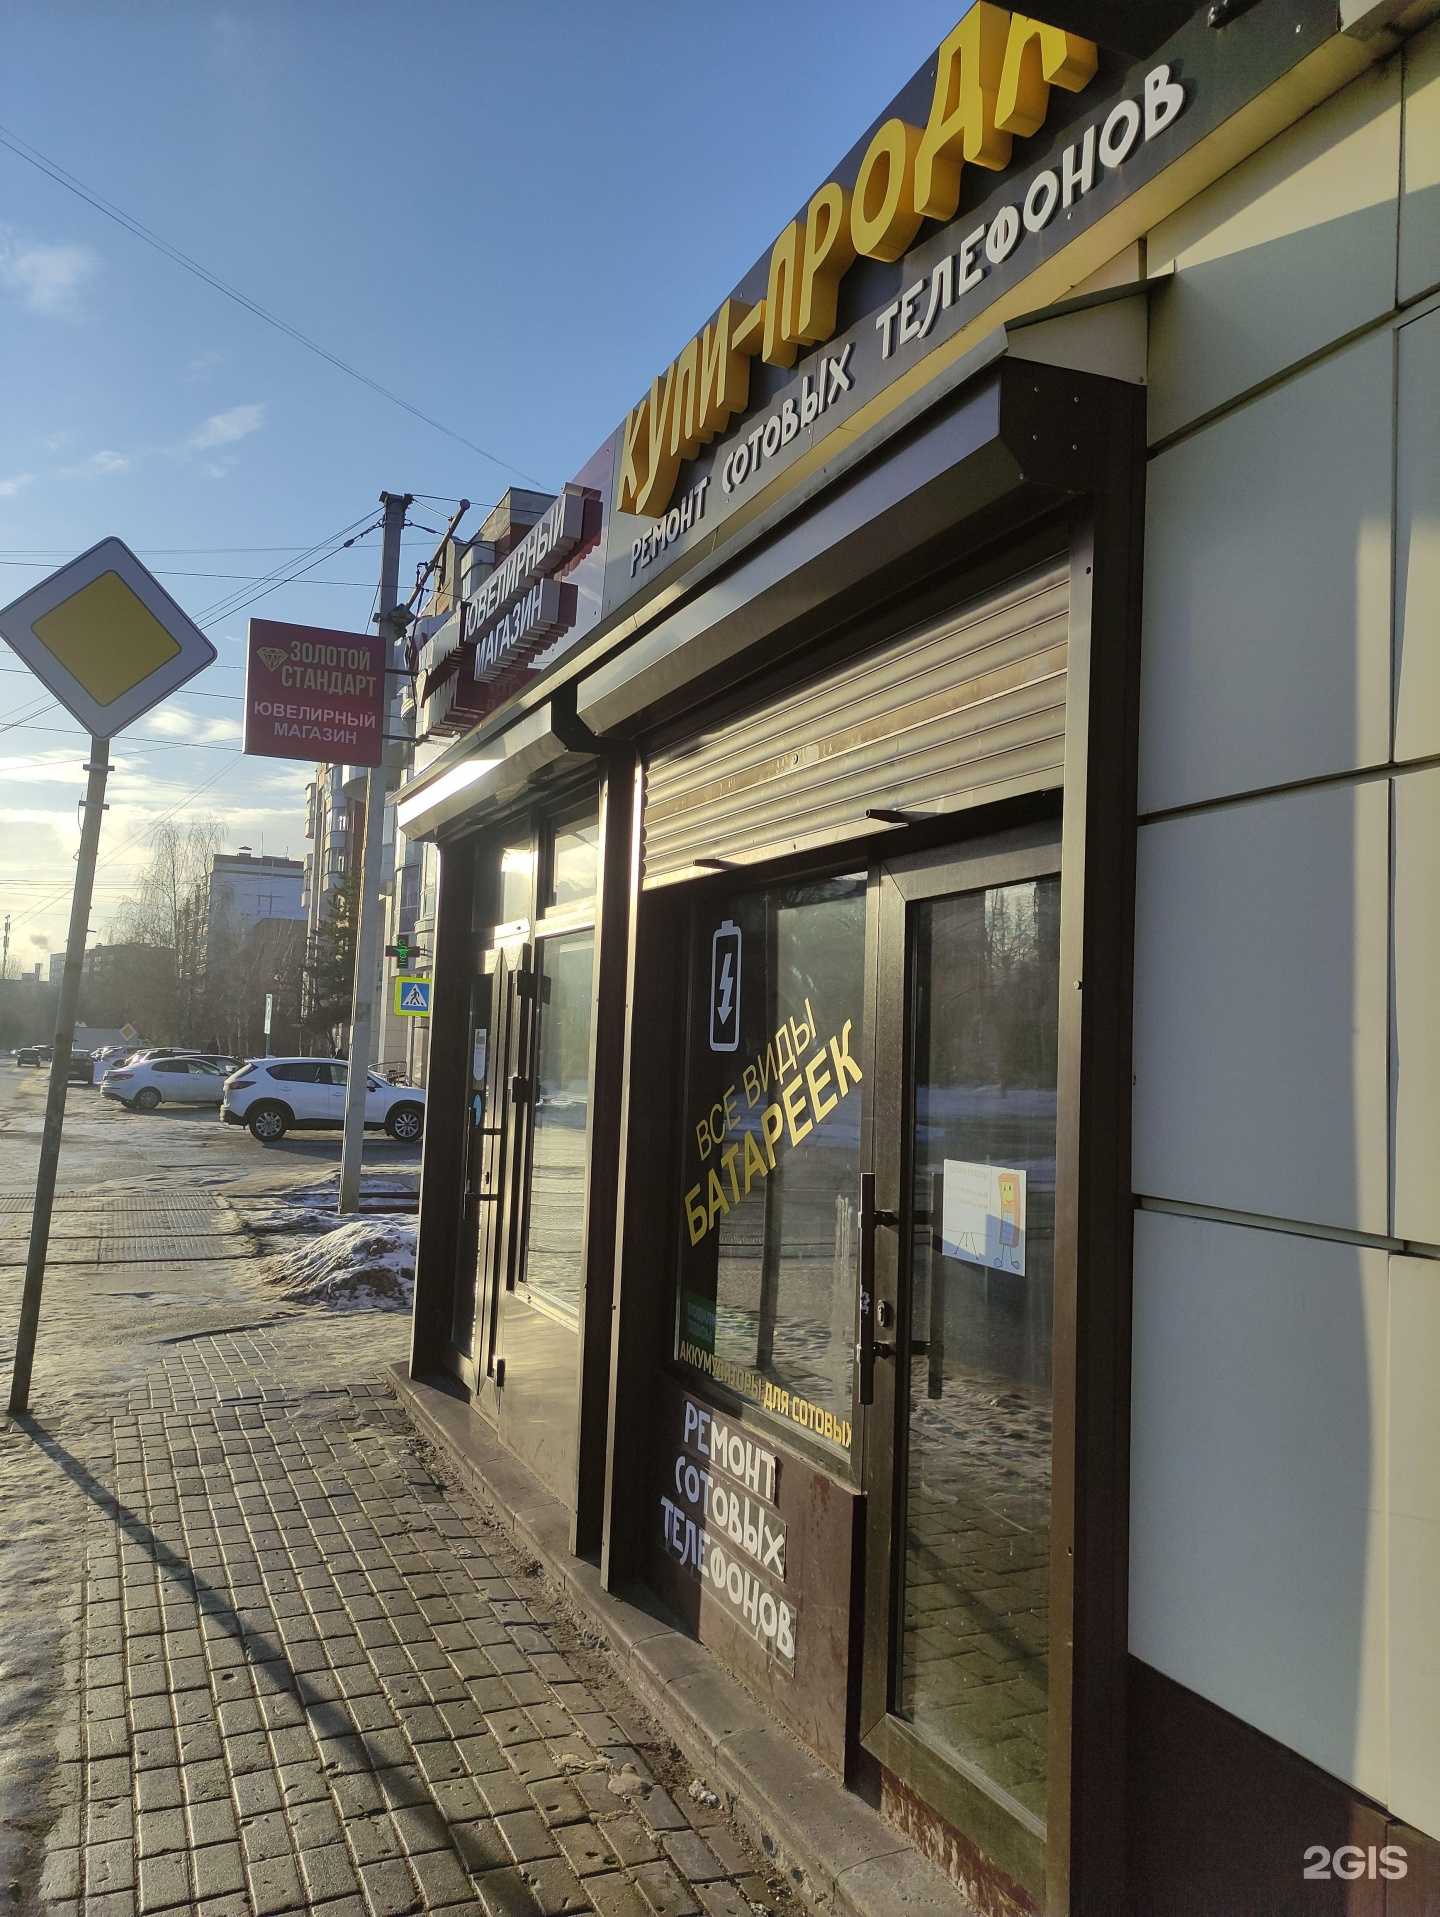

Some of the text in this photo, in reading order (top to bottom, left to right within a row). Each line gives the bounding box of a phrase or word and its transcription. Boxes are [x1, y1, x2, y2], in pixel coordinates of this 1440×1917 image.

[630, 63, 1185, 578] РЕМОНТ СОТОВЫХ ТЕЛЕФОНОВ
[464, 494, 567, 642] ЮВЕЛИРНЫЙ
[281, 665, 377, 697] СТАНДАРТ
[290, 640, 371, 671] ЗОЛОТОЙ
[474, 579, 544, 683] МАГАЗИН
[254, 701, 376, 729] ЮВЕЛИРНЫЙ
[273, 720, 357, 745] МАГАЗИН
[696, 998, 817, 1161] ВСЕ ВИДЫ
[684, 1019, 862, 1247] БАТАРЕЕК
[683, 1401, 776, 1499] РЕМОНТ
[763, 1382, 790, 1416] ДЛЯ
[675, 1456, 785, 1575] СОТОВЫХ
[661, 1496, 794, 1659] ТЕЛЕФОНОВ
